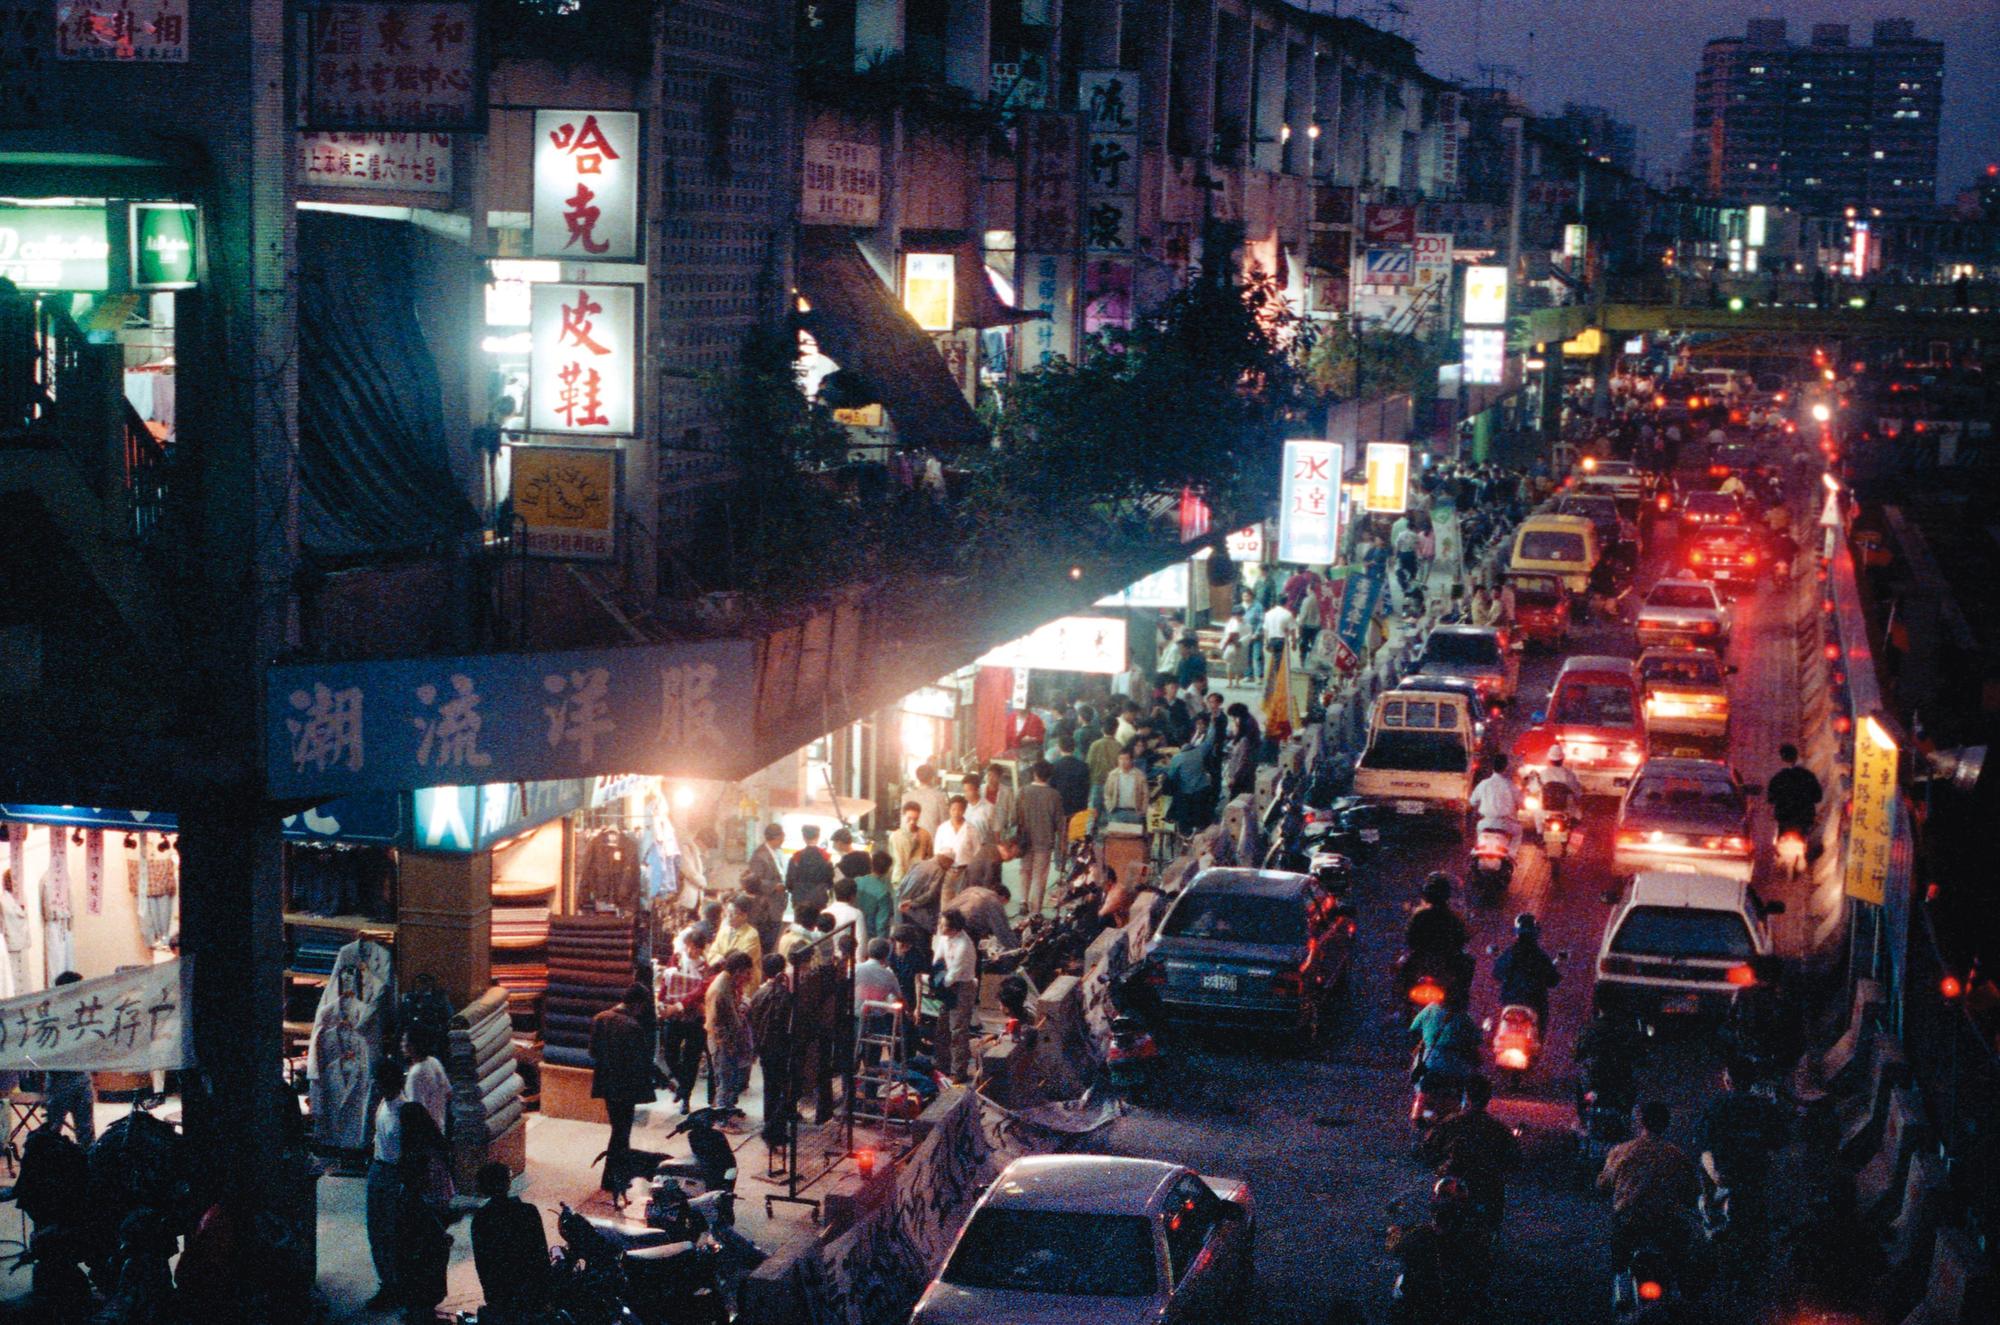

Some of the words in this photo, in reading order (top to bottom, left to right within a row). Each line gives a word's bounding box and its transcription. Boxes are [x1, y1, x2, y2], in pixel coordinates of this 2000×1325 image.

[550, 114, 621, 255] 哈克
[553, 288, 613, 428] 皮鞋
[286, 662, 726, 774] 潮流洋服
